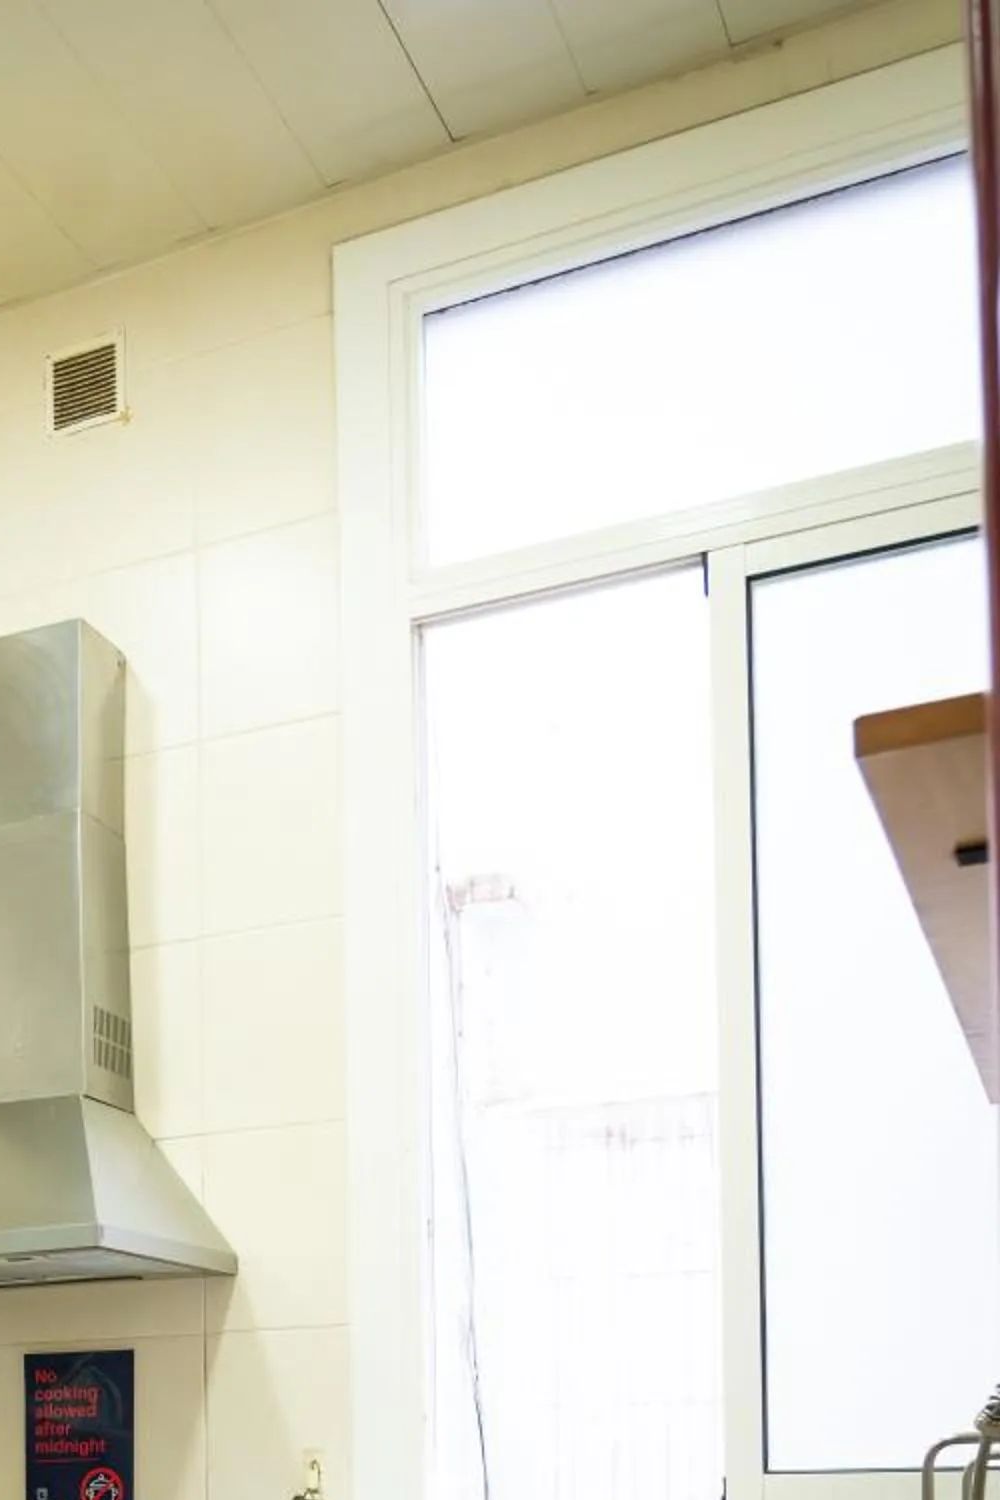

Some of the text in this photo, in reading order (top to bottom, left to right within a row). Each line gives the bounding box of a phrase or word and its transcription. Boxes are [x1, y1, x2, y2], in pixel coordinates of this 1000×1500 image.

[34, 1369, 57, 1384] No
[34, 1386, 99, 1403] cooking
[35, 1404, 97, 1418] allowed
[35, 1423, 71, 1436] after
[35, 1438, 105, 1455] midnight
